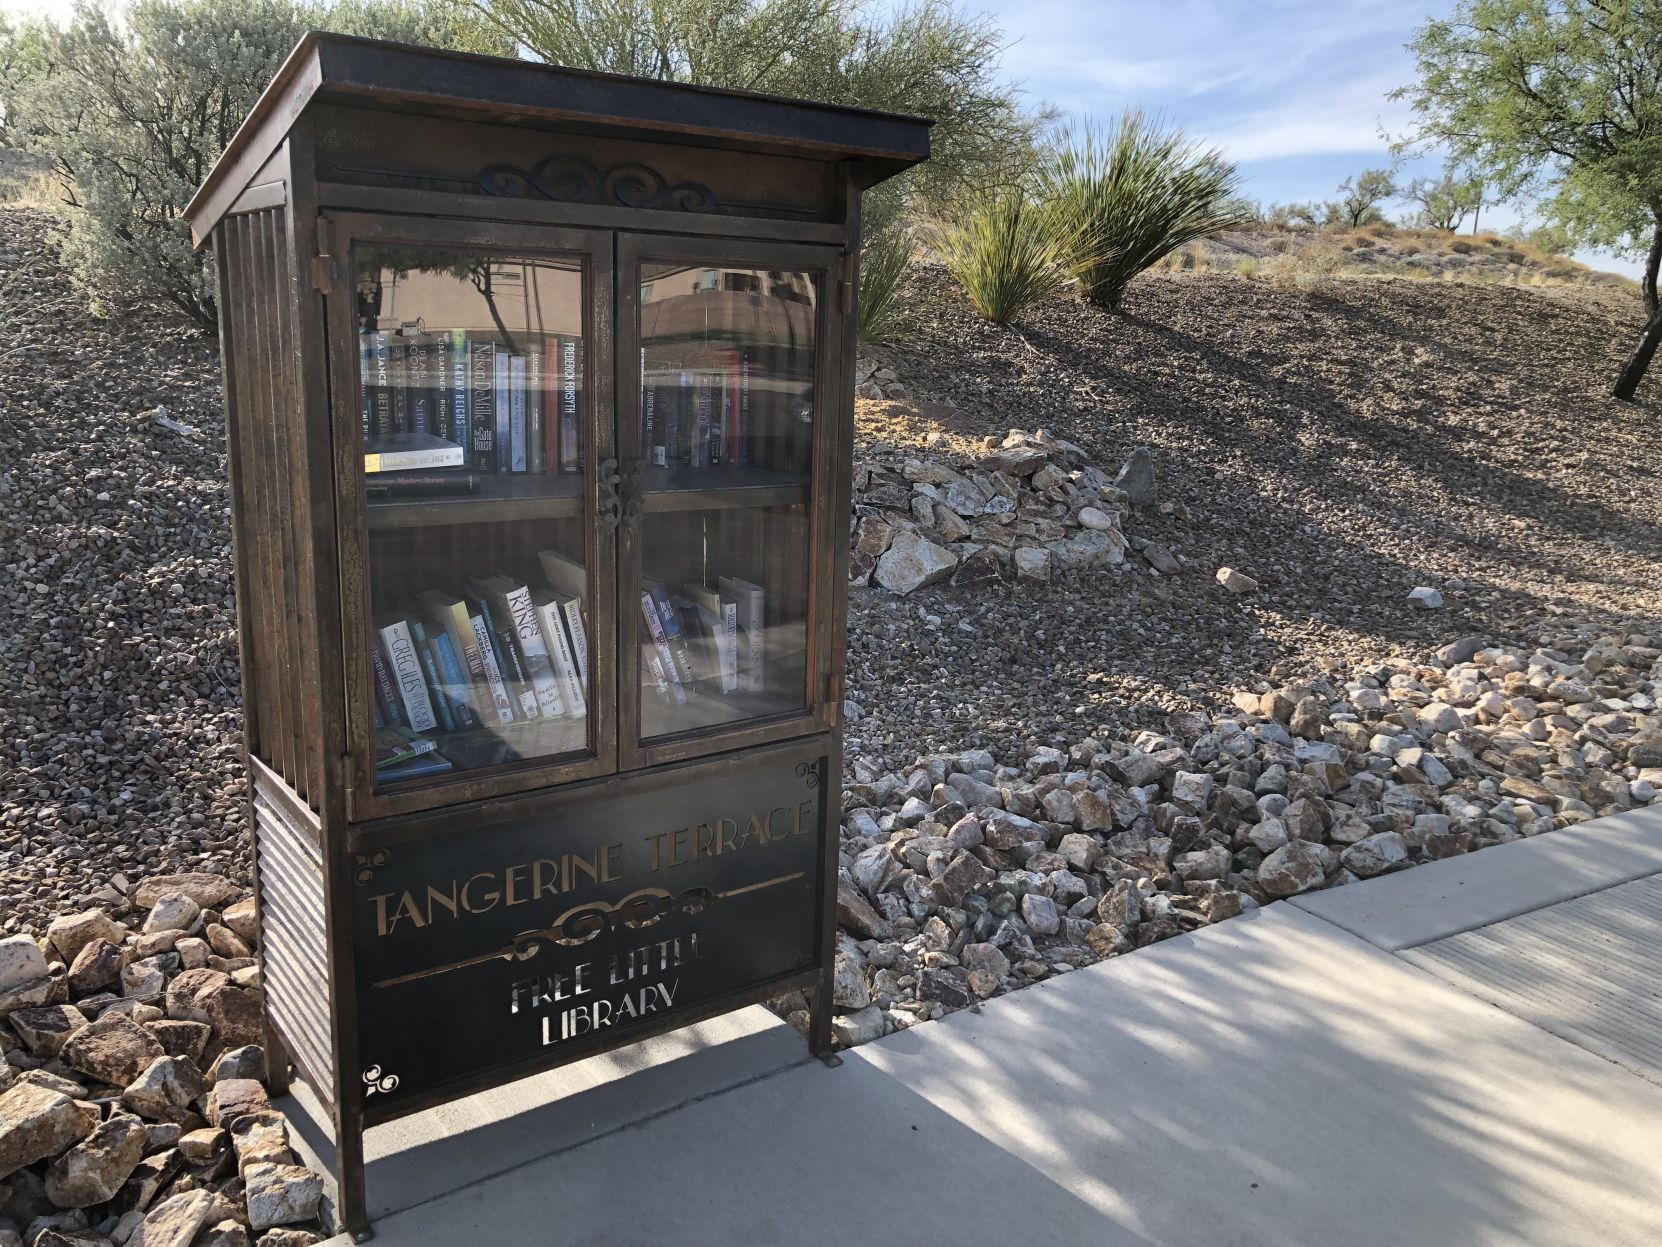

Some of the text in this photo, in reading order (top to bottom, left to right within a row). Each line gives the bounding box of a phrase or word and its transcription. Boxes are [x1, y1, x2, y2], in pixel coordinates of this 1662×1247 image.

[378, 355, 387, 386] JANCE
[409, 340, 420, 388] KOONTZ
[454, 364, 464, 391] KATHY
[564, 342, 575, 380] FREDERICK
[474, 344, 492, 421] Nelson DeMille
[564, 382, 576, 414] FORSYTH
[378, 393, 389, 435] BETRAYA
[456, 394, 465, 425] REICHS
[474, 440, 492, 451] House
[509, 596, 534, 640] KING
[522, 590, 540, 636] STEPHEN
[464, 644, 483, 674] FREEMAN
[480, 626, 492, 653] CAMILLA
[574, 625, 586, 654] PEARSON
[372, 649, 395, 702] DAVID BALDACCI
[392, 638, 422, 693] GREG ILES
[368, 800, 812, 936] TANGERINE TERRACE
[511, 962, 592, 1014] FREE
[542, 978, 679, 1046] LIBRARY
